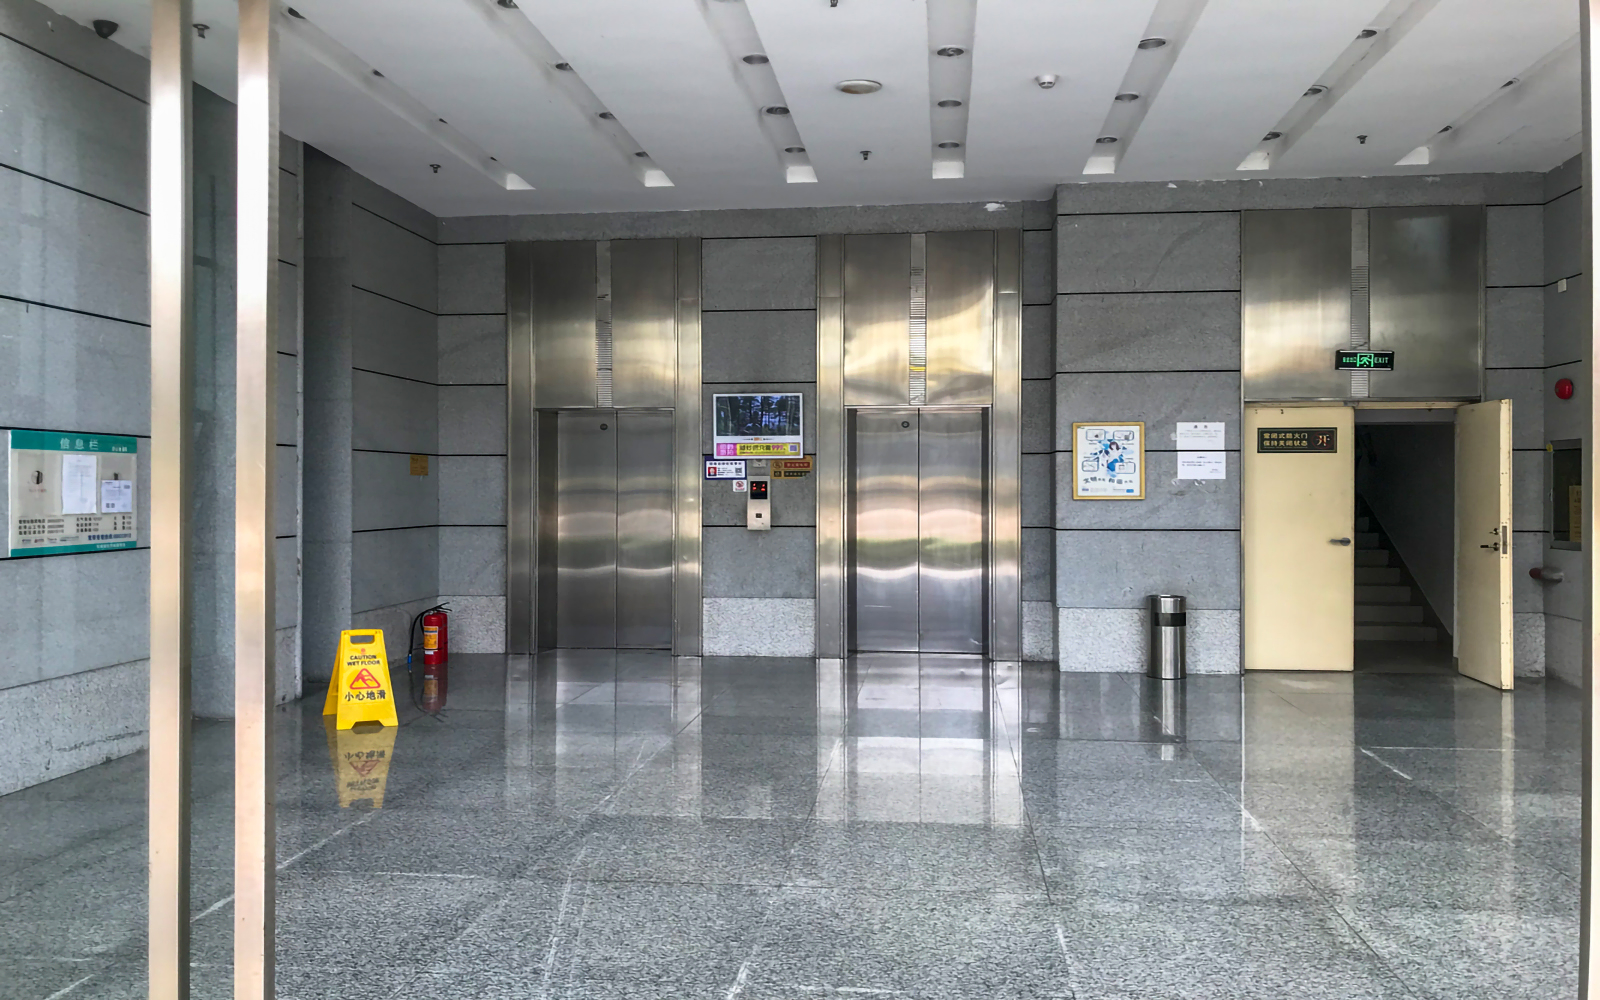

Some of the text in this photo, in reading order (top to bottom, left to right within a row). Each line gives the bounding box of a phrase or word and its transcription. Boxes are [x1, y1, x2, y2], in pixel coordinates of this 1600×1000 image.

[1374, 355, 1389, 364] EXIT
[60, 438, 99, 450] 信息栏
[345, 690, 386, 702] 小心地滑
